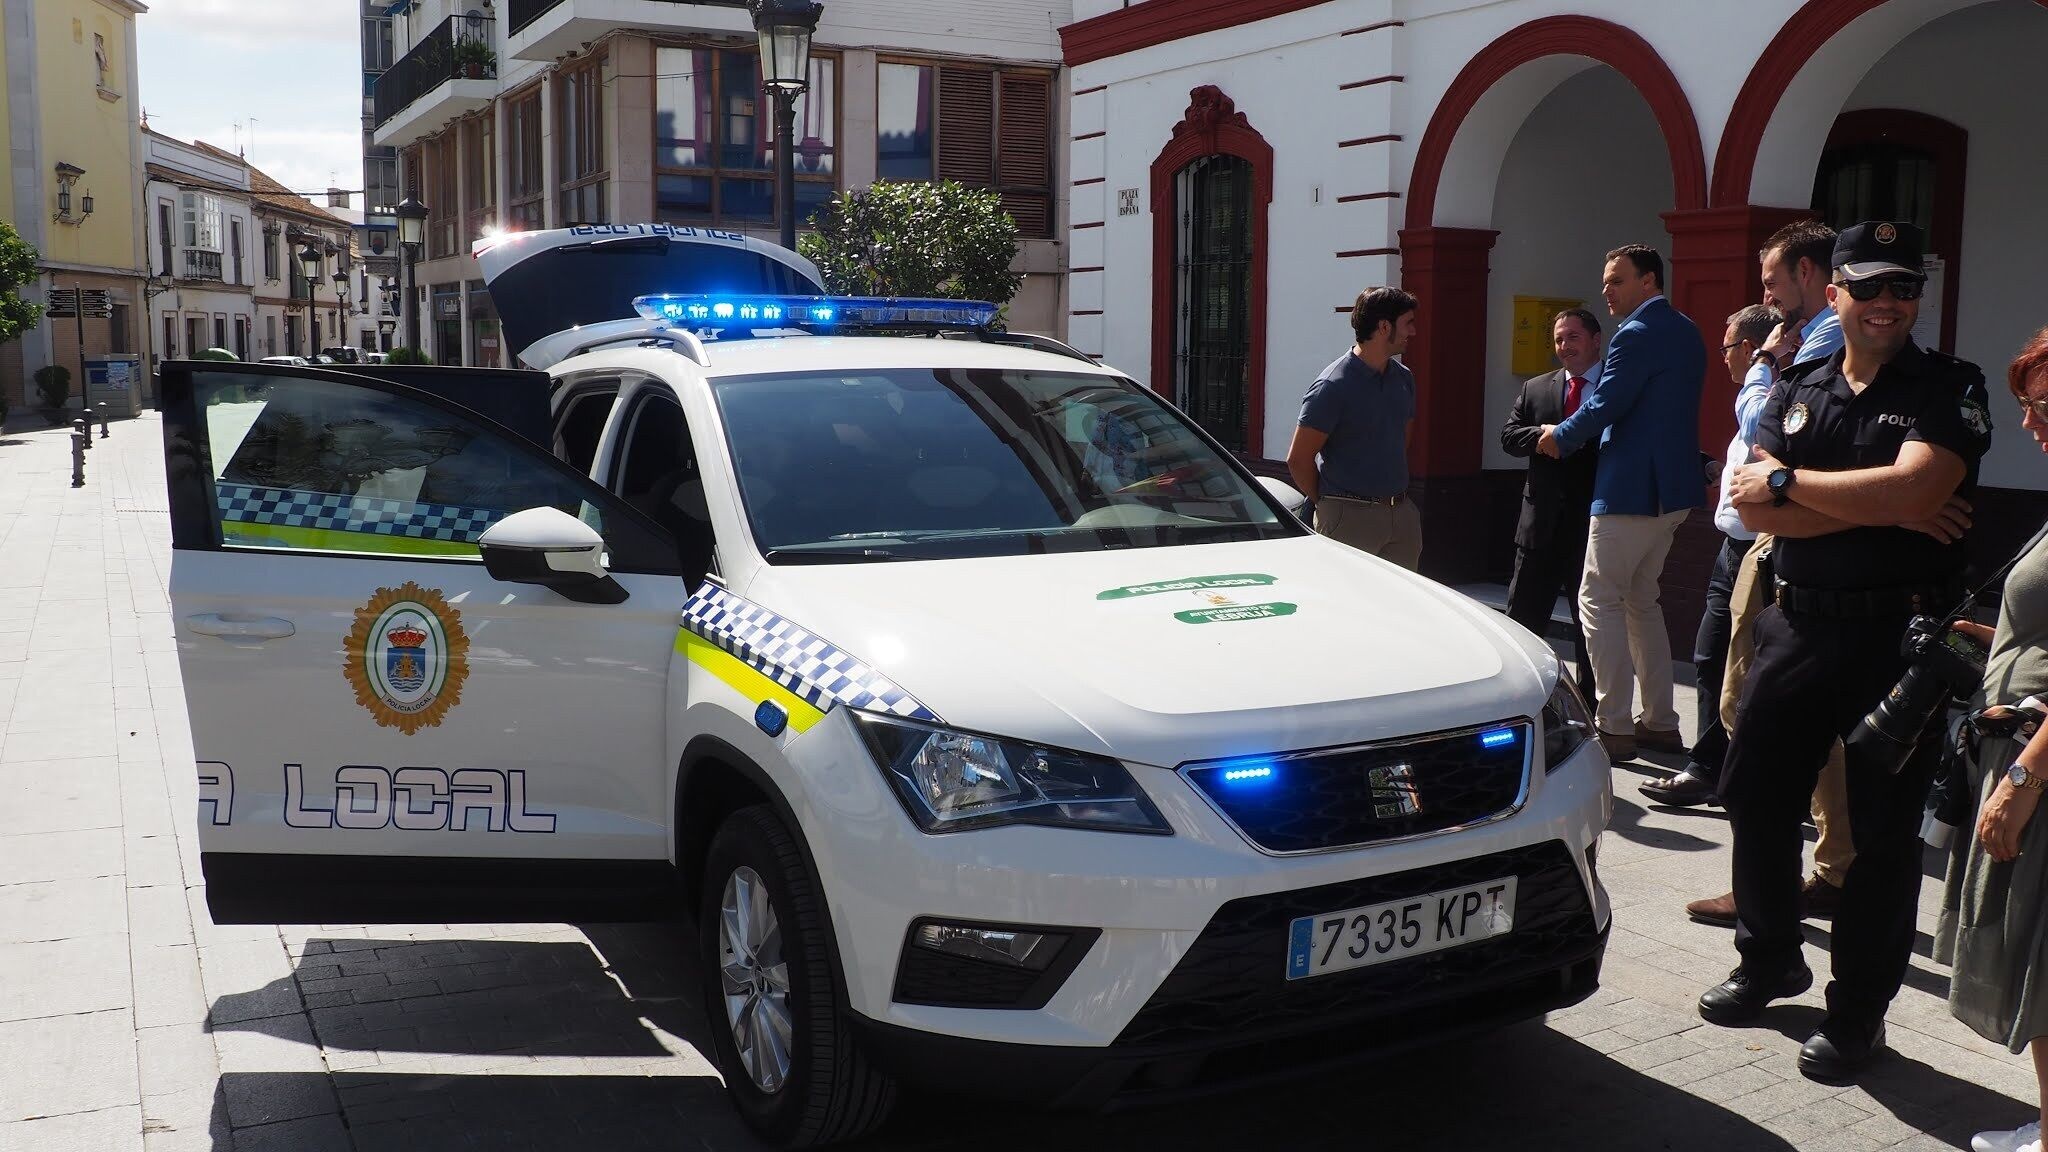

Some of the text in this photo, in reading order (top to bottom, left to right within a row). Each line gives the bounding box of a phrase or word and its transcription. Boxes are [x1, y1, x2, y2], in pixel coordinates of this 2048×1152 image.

[1121, 190, 1138, 199] PLAZA
[1120, 205, 1139, 215] ESPAÑA
[1202, 578, 1266, 587] LOCAL
[1205, 610, 1276, 622] LEBRIJA
[411, 697, 432, 711] LOCAL
[283, 763, 557, 834] LOCAL
[1320, 884, 1506, 966] 7335 KPT
[1296, 954, 1304, 967] E
